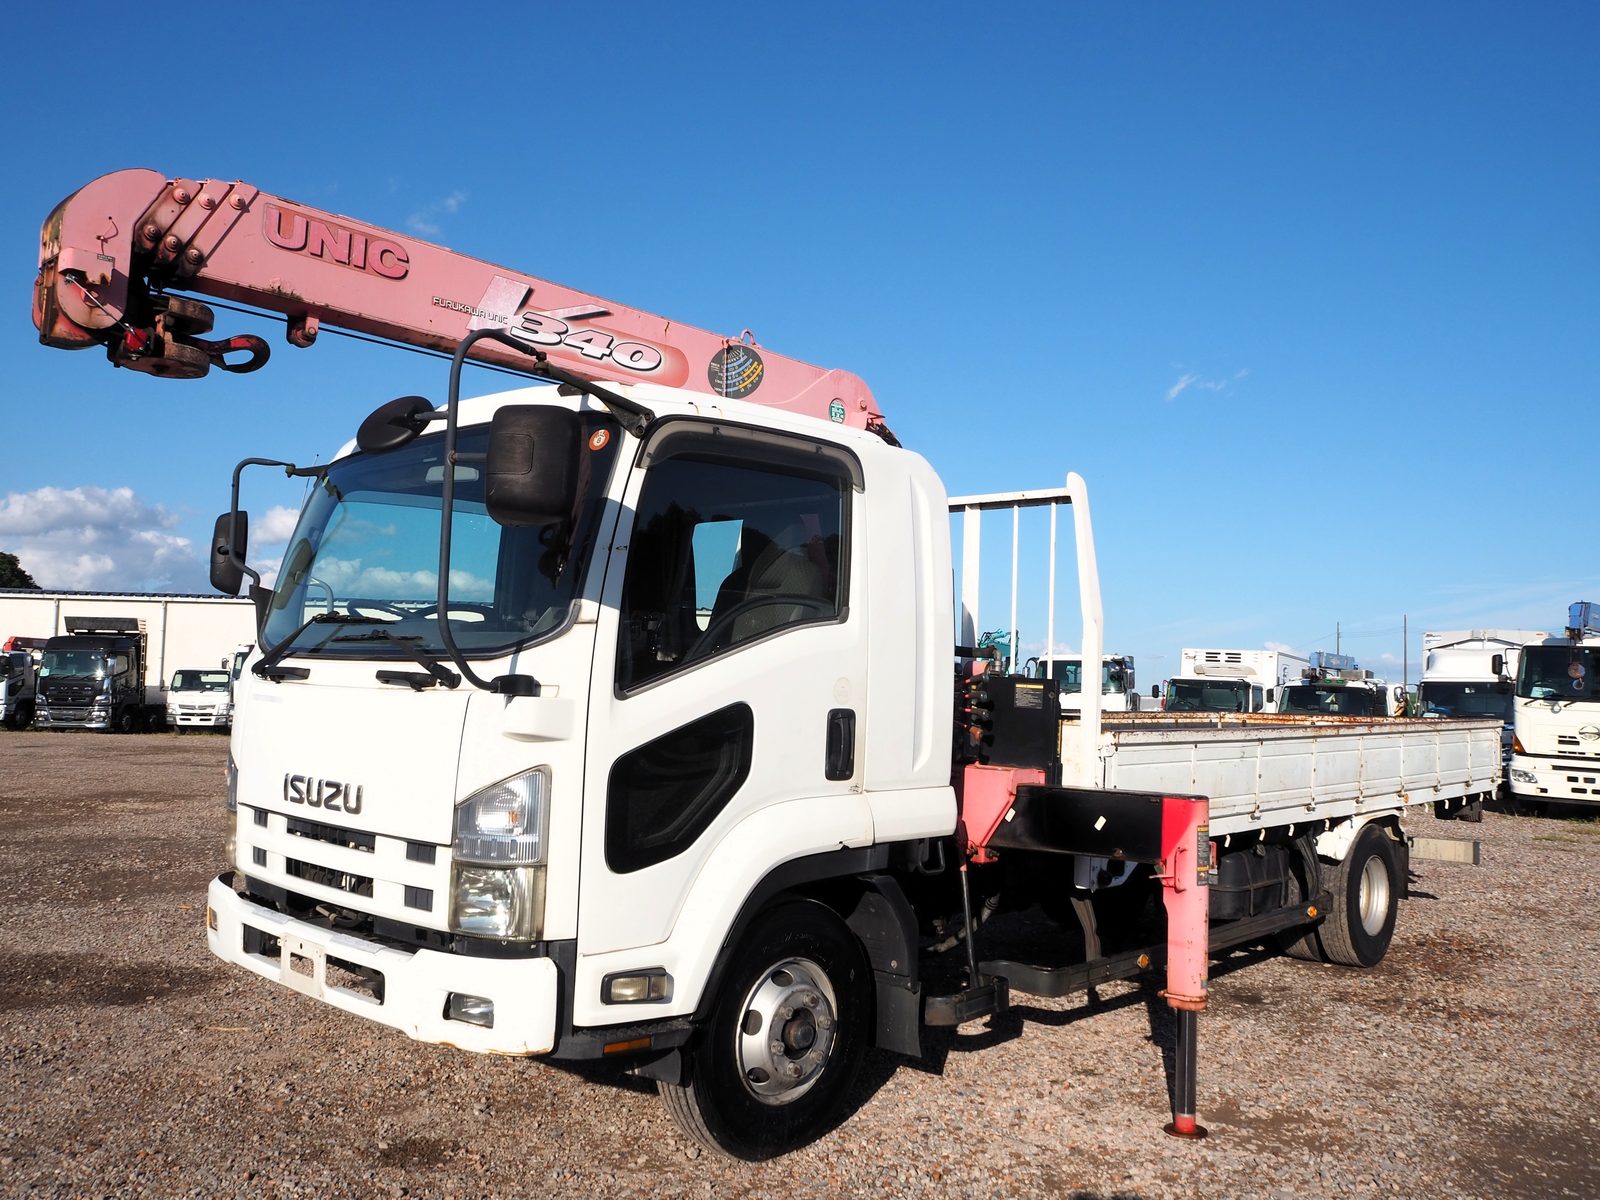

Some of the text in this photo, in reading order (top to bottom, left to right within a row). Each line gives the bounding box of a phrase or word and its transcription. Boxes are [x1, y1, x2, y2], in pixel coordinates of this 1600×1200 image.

[265, 208, 410, 281] UNIC
[432, 296, 508, 325] FURUKAWA UNIC
[510, 311, 662, 371] 340
[283, 773, 364, 815] ISUZU
